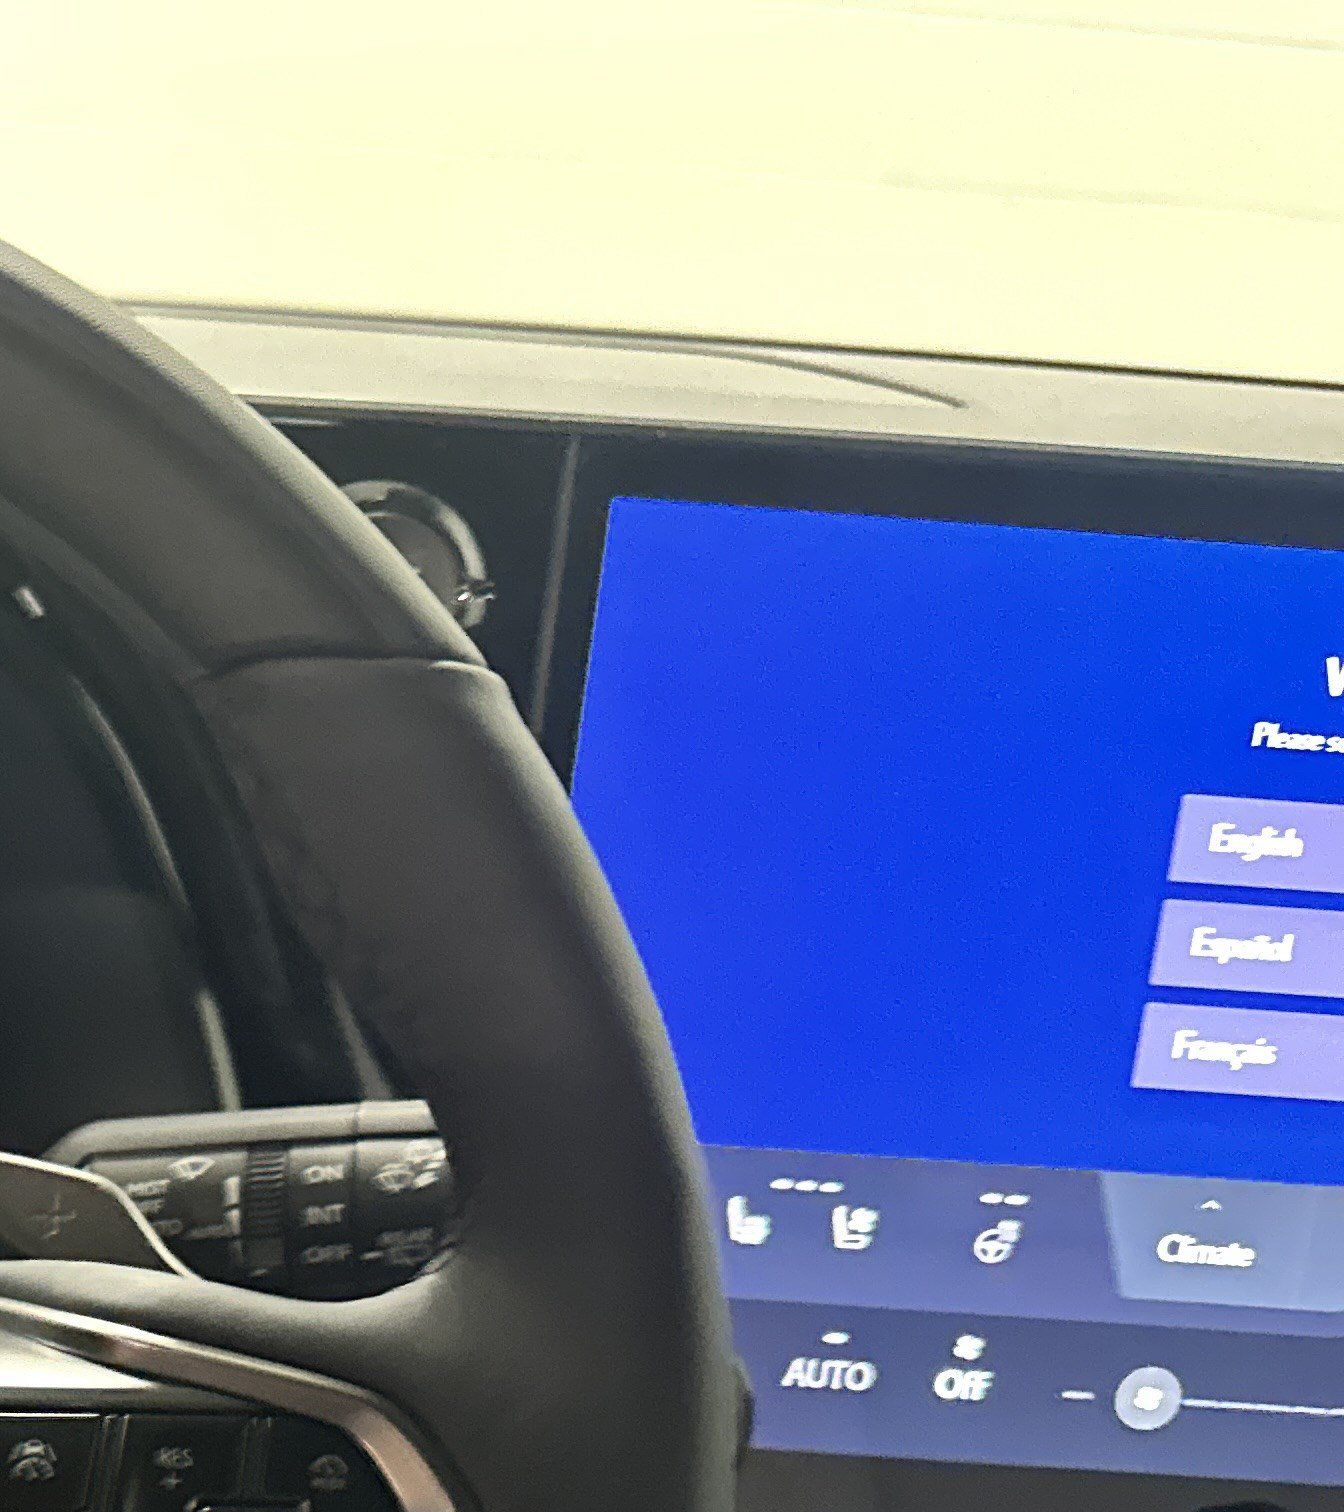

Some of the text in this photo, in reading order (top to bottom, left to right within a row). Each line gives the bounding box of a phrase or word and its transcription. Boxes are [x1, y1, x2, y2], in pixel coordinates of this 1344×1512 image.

[1250, 721, 1326, 751] Please
[1208, 822, 1304, 861] English
[1189, 926, 1295, 965] Español
[1171, 1029, 1278, 1071] Français
[303, 1165, 343, 1184] ON
[1156, 1234, 1255, 1267] Climate
[781, 1357, 877, 1392] AUTO
[933, 1368, 994, 1400] OFF
